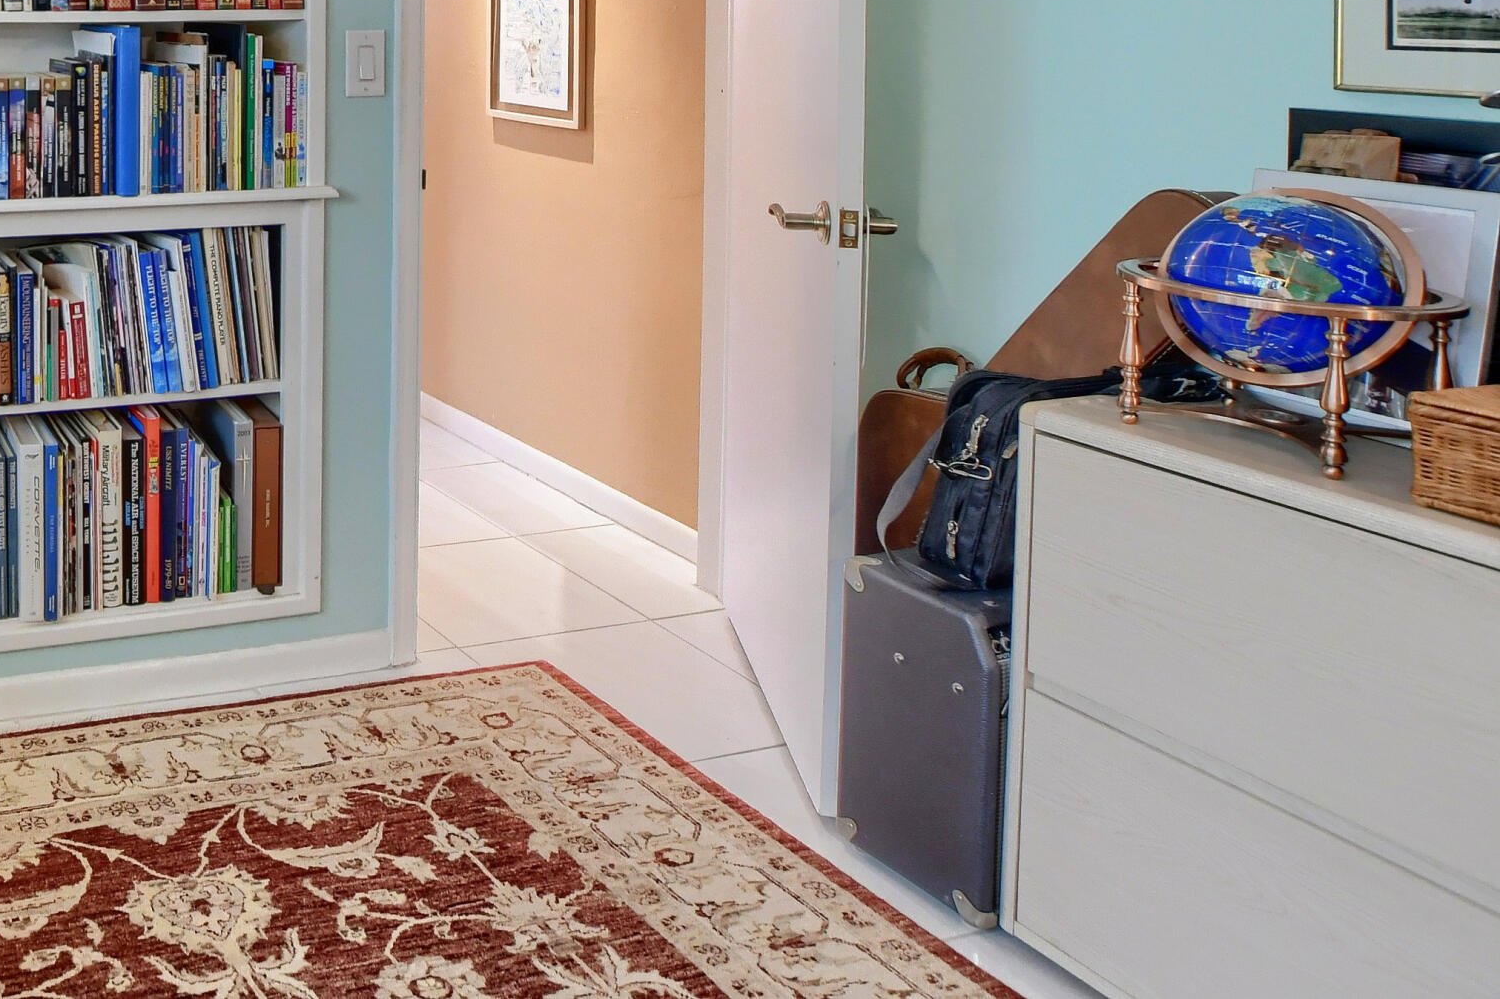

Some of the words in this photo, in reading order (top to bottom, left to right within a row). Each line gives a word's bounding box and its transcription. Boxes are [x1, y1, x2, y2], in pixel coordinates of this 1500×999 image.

[211, 260, 220, 296] COMPLETE
[22, 280, 30, 344] MOUNTAINEERING
[1, 344, 10, 385] ASHES
[101, 444, 110, 475] Military
[131, 442, 139, 458] The
[165, 446, 173, 461] USS
[102, 477, 110, 506] Aircraft
[131, 459, 139, 502] NATIONAL
[165, 462, 173, 490] NIMITZ
[33, 476, 41, 571] CORVETTE
